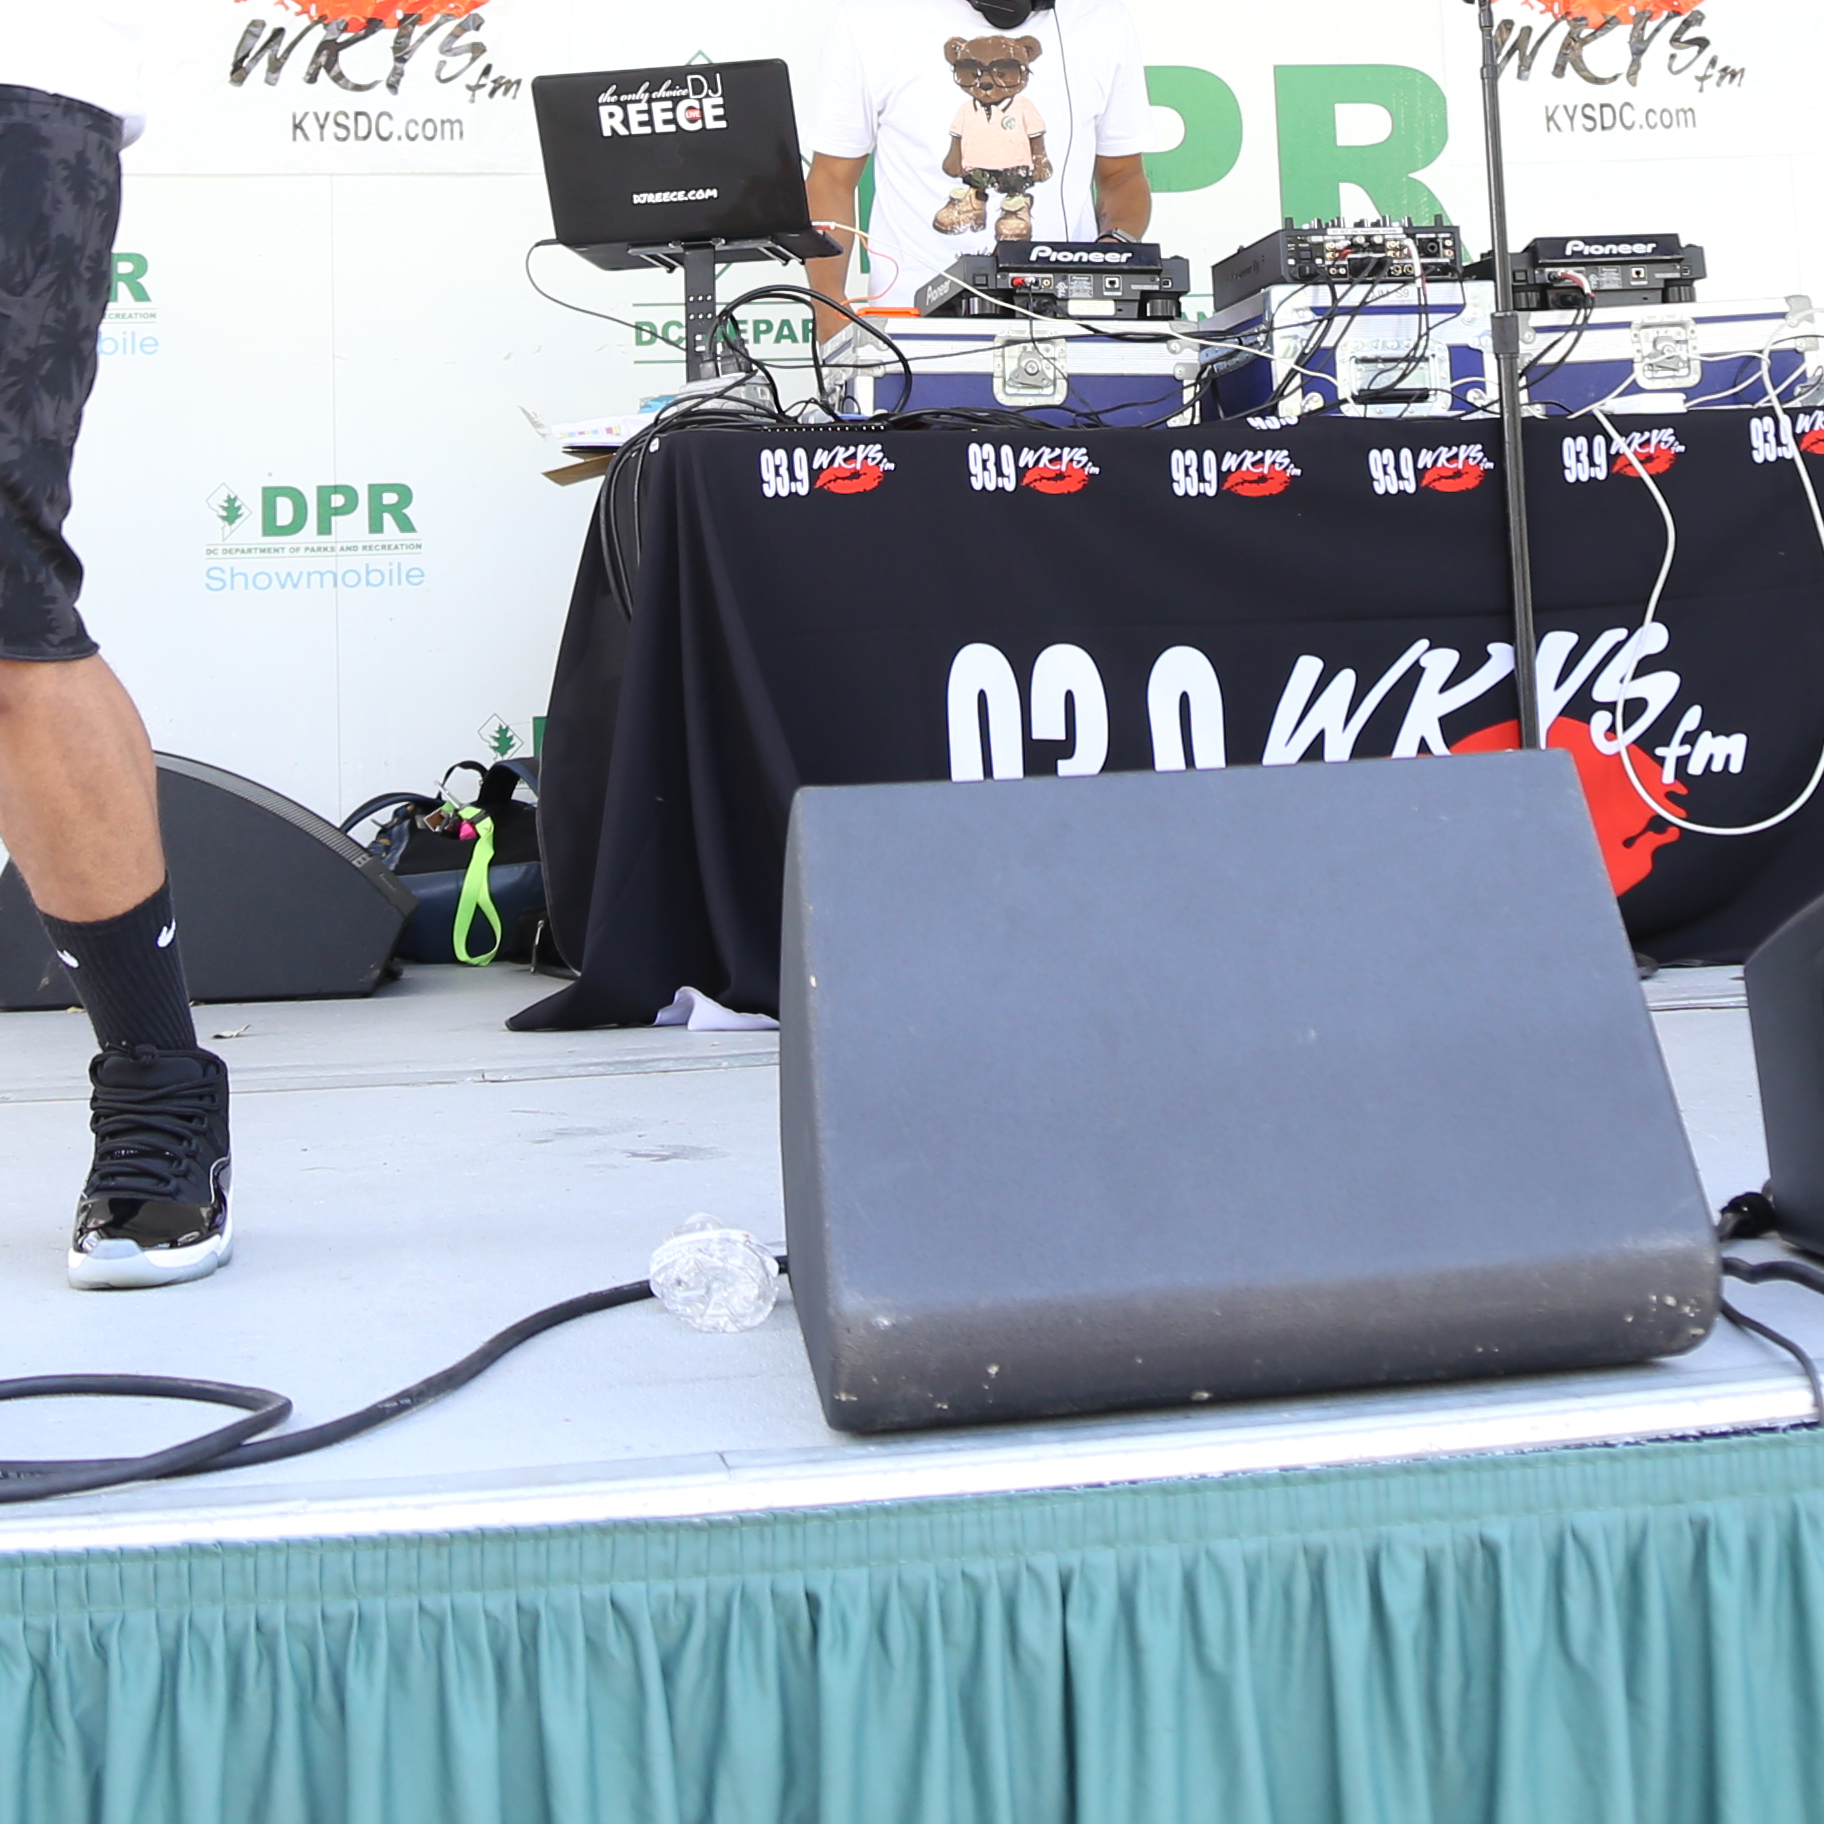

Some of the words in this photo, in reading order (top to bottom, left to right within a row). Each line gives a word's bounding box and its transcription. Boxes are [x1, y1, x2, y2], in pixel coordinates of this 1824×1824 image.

[229, 13, 488, 95] WKYS
[465, 63, 523, 104] fm
[1495, 10, 1711, 87] WKYS
[1694, 54, 1746, 93] fm
[597, 84, 618, 104] the
[619, 81, 651, 104] only
[651, 79, 689, 99] choice
[687, 73, 723, 99] DJ
[292, 111, 464, 143] KYSDC.com
[598, 97, 728, 137] REECE
[685, 110, 702, 120] LIVE
[1545, 102, 1696, 133] KYSDC.com
[632, 188, 718, 204] DJREECE.COM
[1029, 245, 1133, 264] Pioneer
[1565, 239, 1658, 256] Pioneer
[1562, 435, 1608, 483] 93.9
[1610, 428, 1676, 456] WKYS
[1671, 441, 1686, 454] fm
[1749, 416, 1795, 464] 93.9
[760, 449, 810, 497] 93.9
[812, 443, 884, 470] WKYS
[879, 461, 896, 473] fm
[968, 442, 1017, 492] 93.9
[1018, 444, 1090, 471] WKYS
[1085, 463, 1101, 475] fm
[1169, 449, 1218, 497] 93.9
[1221, 448, 1292, 474] WKYS
[1287, 465, 1303, 477] fm
[1368, 447, 1416, 495] 93.9
[1416, 444, 1484, 469] WKYS
[1479, 458, 1495, 471] fm
[261, 483, 418, 537] DPR
[222, 546, 285, 555] DEPARTMENT
[304, 545, 336, 553] PARKS
[339, 544, 359, 552] AND
[362, 543, 423, 551] RECREATION
[205, 562, 425, 592] Showmobile
[1262, 621, 1681, 766] WKYS
[1655, 705, 1749, 783] fm
